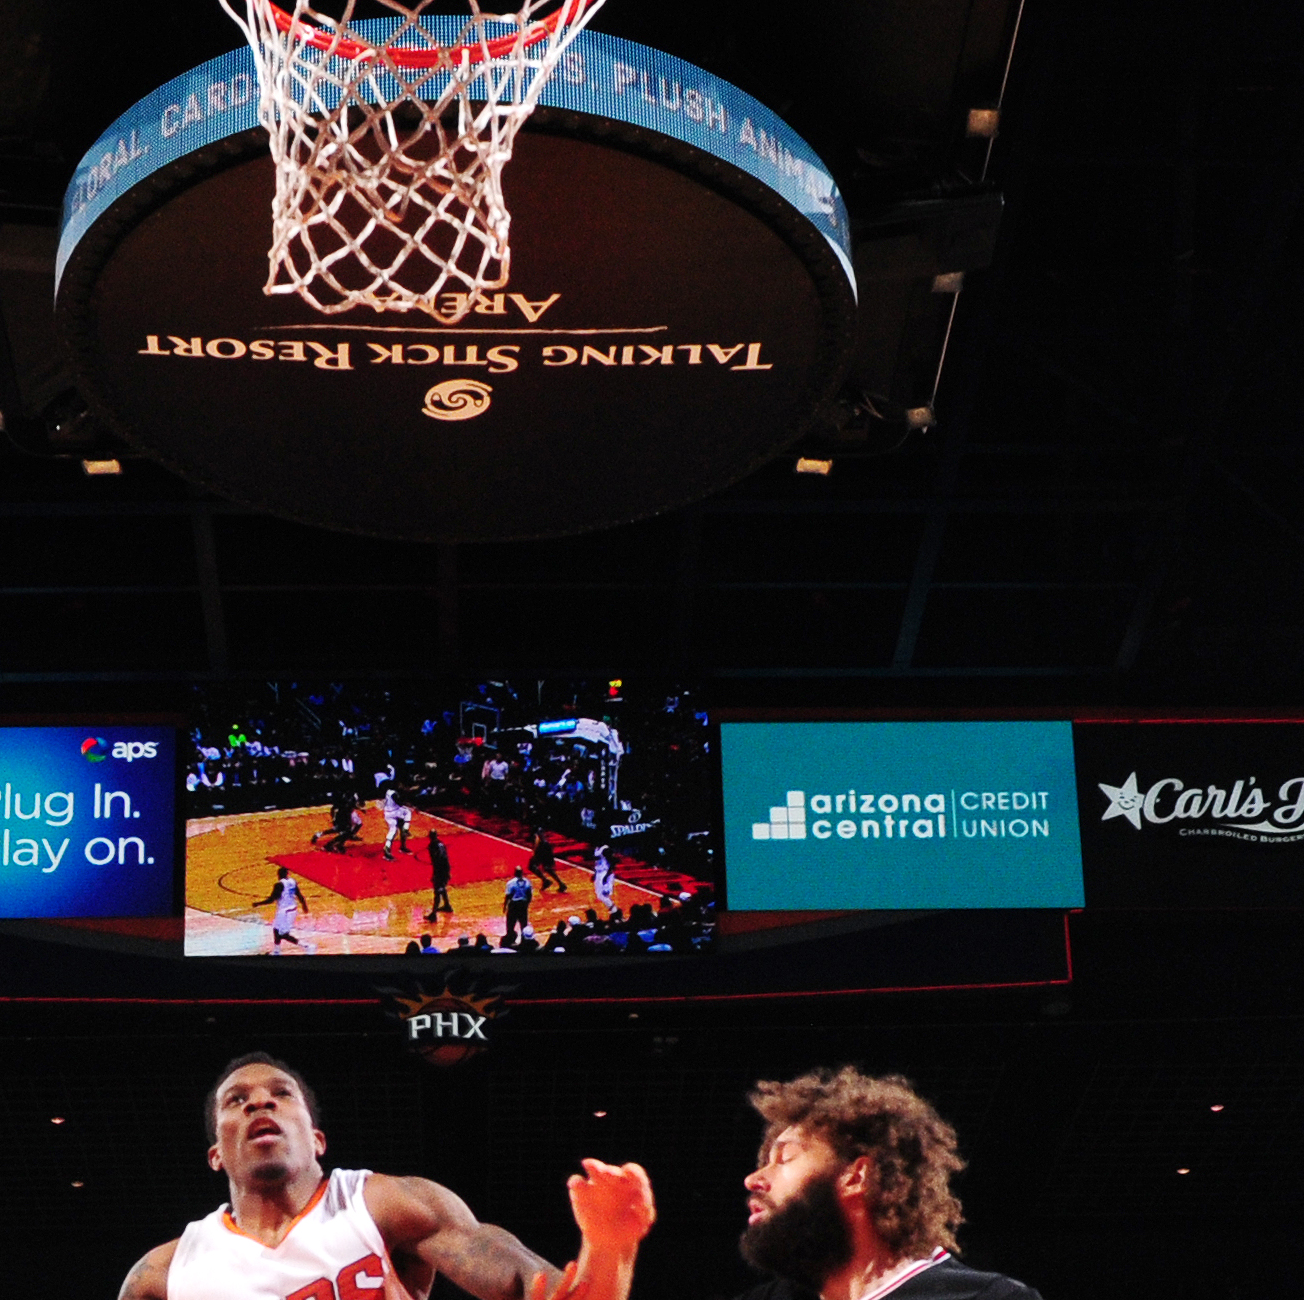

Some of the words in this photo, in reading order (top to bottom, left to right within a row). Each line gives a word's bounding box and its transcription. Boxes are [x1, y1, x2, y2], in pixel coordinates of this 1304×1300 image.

[613, 62, 727, 133] PLUSH
[111, 740, 158, 763] aps
[93, 783, 141, 820] In.
[810, 789, 946, 814] arizona
[960, 791, 1050, 811] CREDIT
[1145, 776, 1272, 824] Carl's
[812, 815, 946, 839] central
[961, 818, 1050, 838] UNION
[1179, 827, 1258, 842] CHARBROILED
[83, 833, 155, 866] on.
[408, 1011, 489, 1041] PHX
